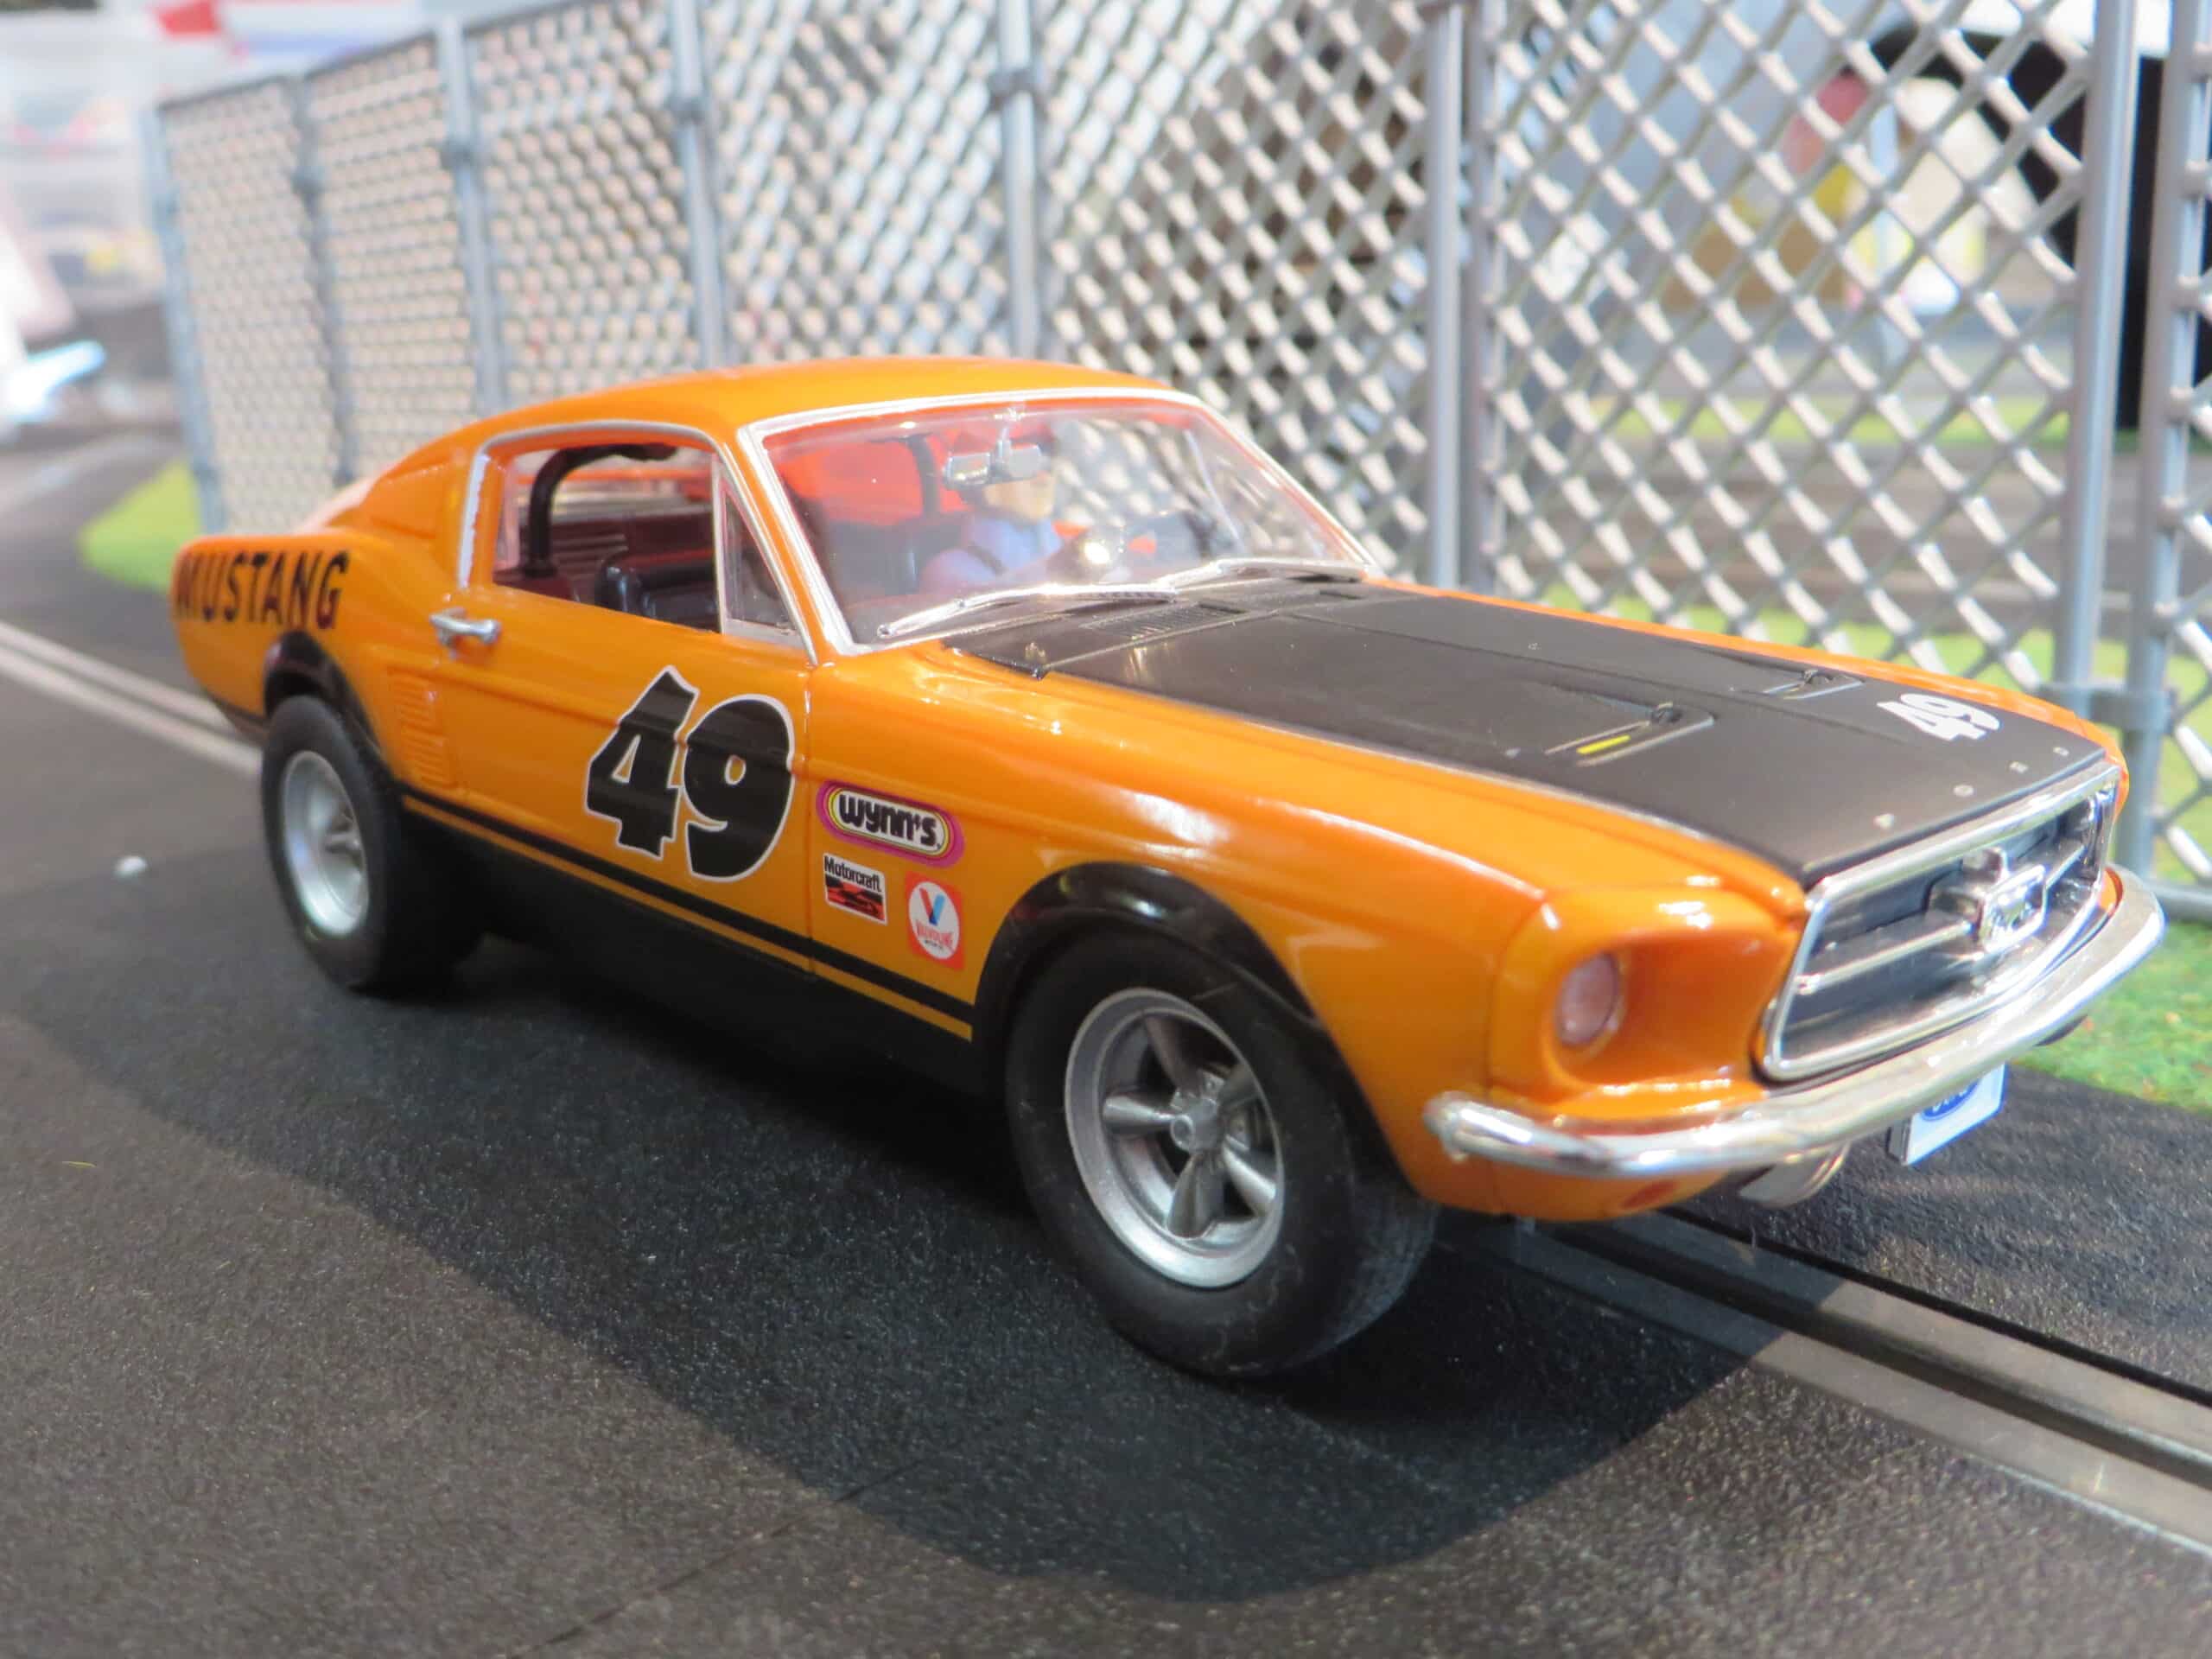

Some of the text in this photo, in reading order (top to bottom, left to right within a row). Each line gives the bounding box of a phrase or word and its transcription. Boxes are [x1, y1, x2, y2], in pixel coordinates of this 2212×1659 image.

[173, 550, 349, 629] MUSTANG
[1876, 694, 2000, 741] 49
[584, 664, 795, 882] 49
[823, 855, 881, 892] Motorcraft
